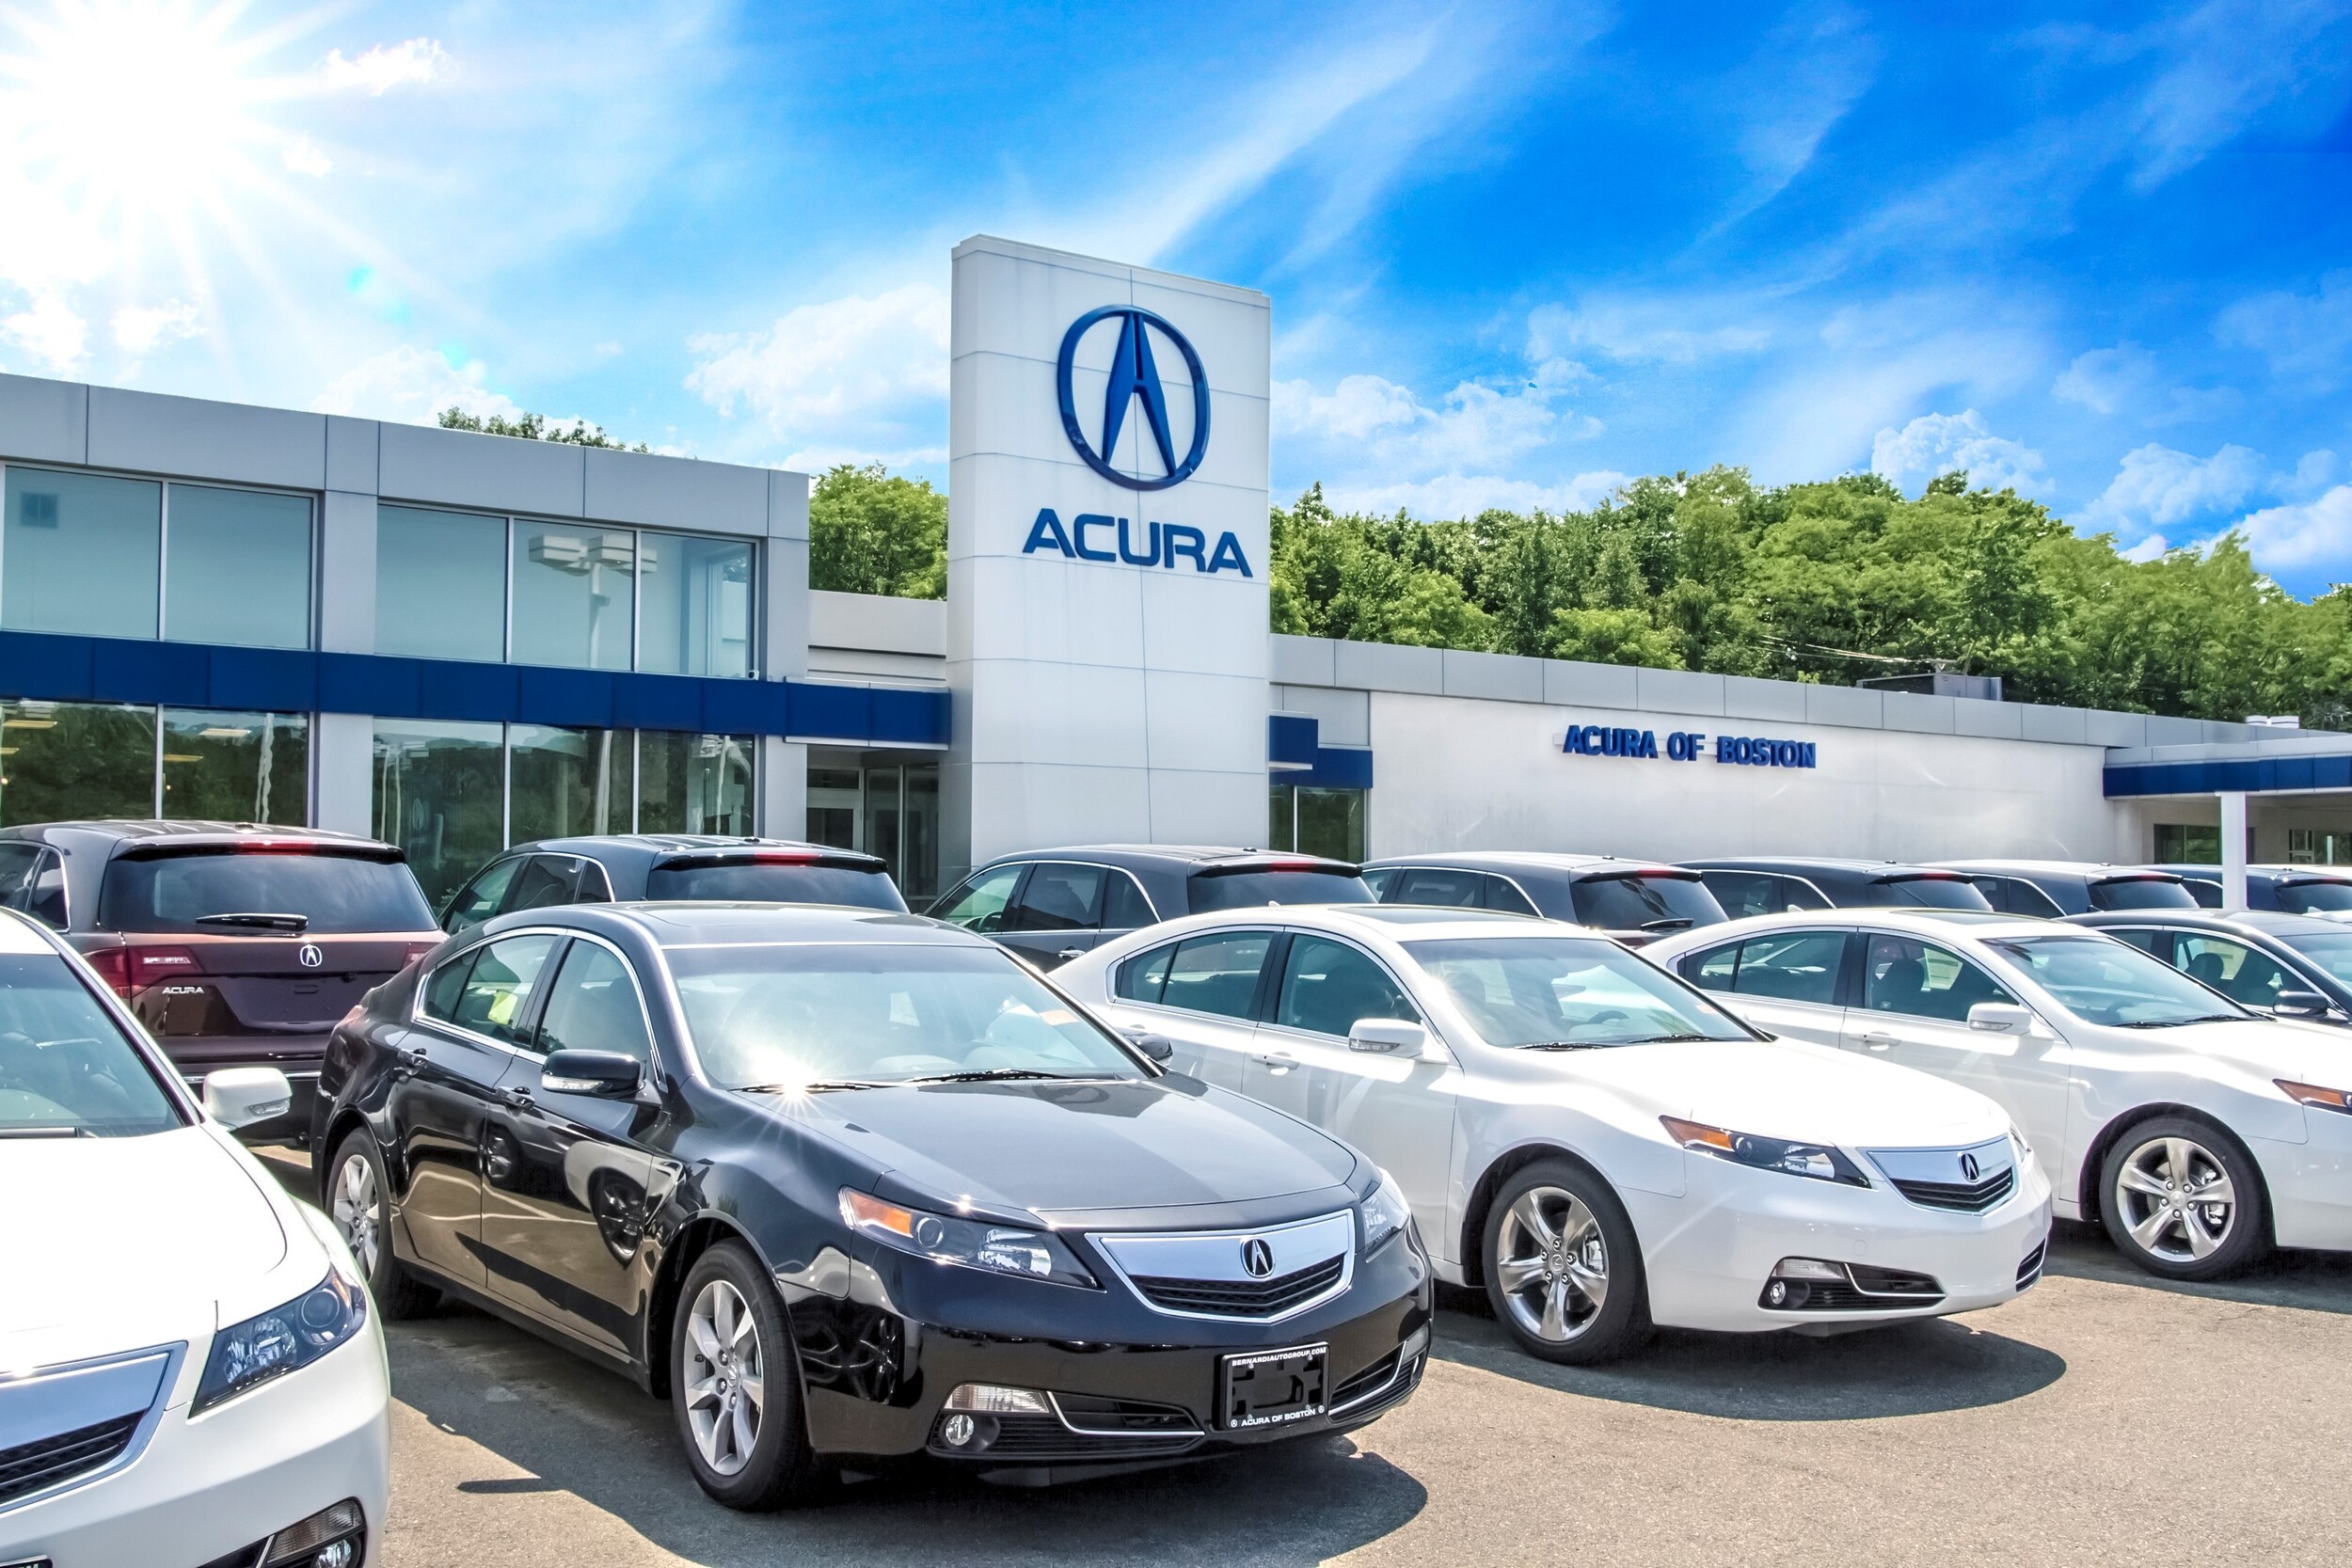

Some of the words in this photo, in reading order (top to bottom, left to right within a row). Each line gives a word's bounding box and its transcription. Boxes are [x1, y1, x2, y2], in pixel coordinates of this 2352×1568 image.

[1022, 507, 1254, 578] ACURA
[1562, 724, 1659, 759] ACURA
[1666, 731, 1707, 762] OF
[1716, 736, 1817, 769] BOSTON
[162, 986, 205, 995] ACURA
[1232, 1346, 1327, 1367] BERNARDIAUTOGROUP.COM
[1241, 1415, 1271, 1427] ACURA
[1271, 1413, 1283, 1422] OF
[1284, 1408, 1316, 1421] BOSTON
